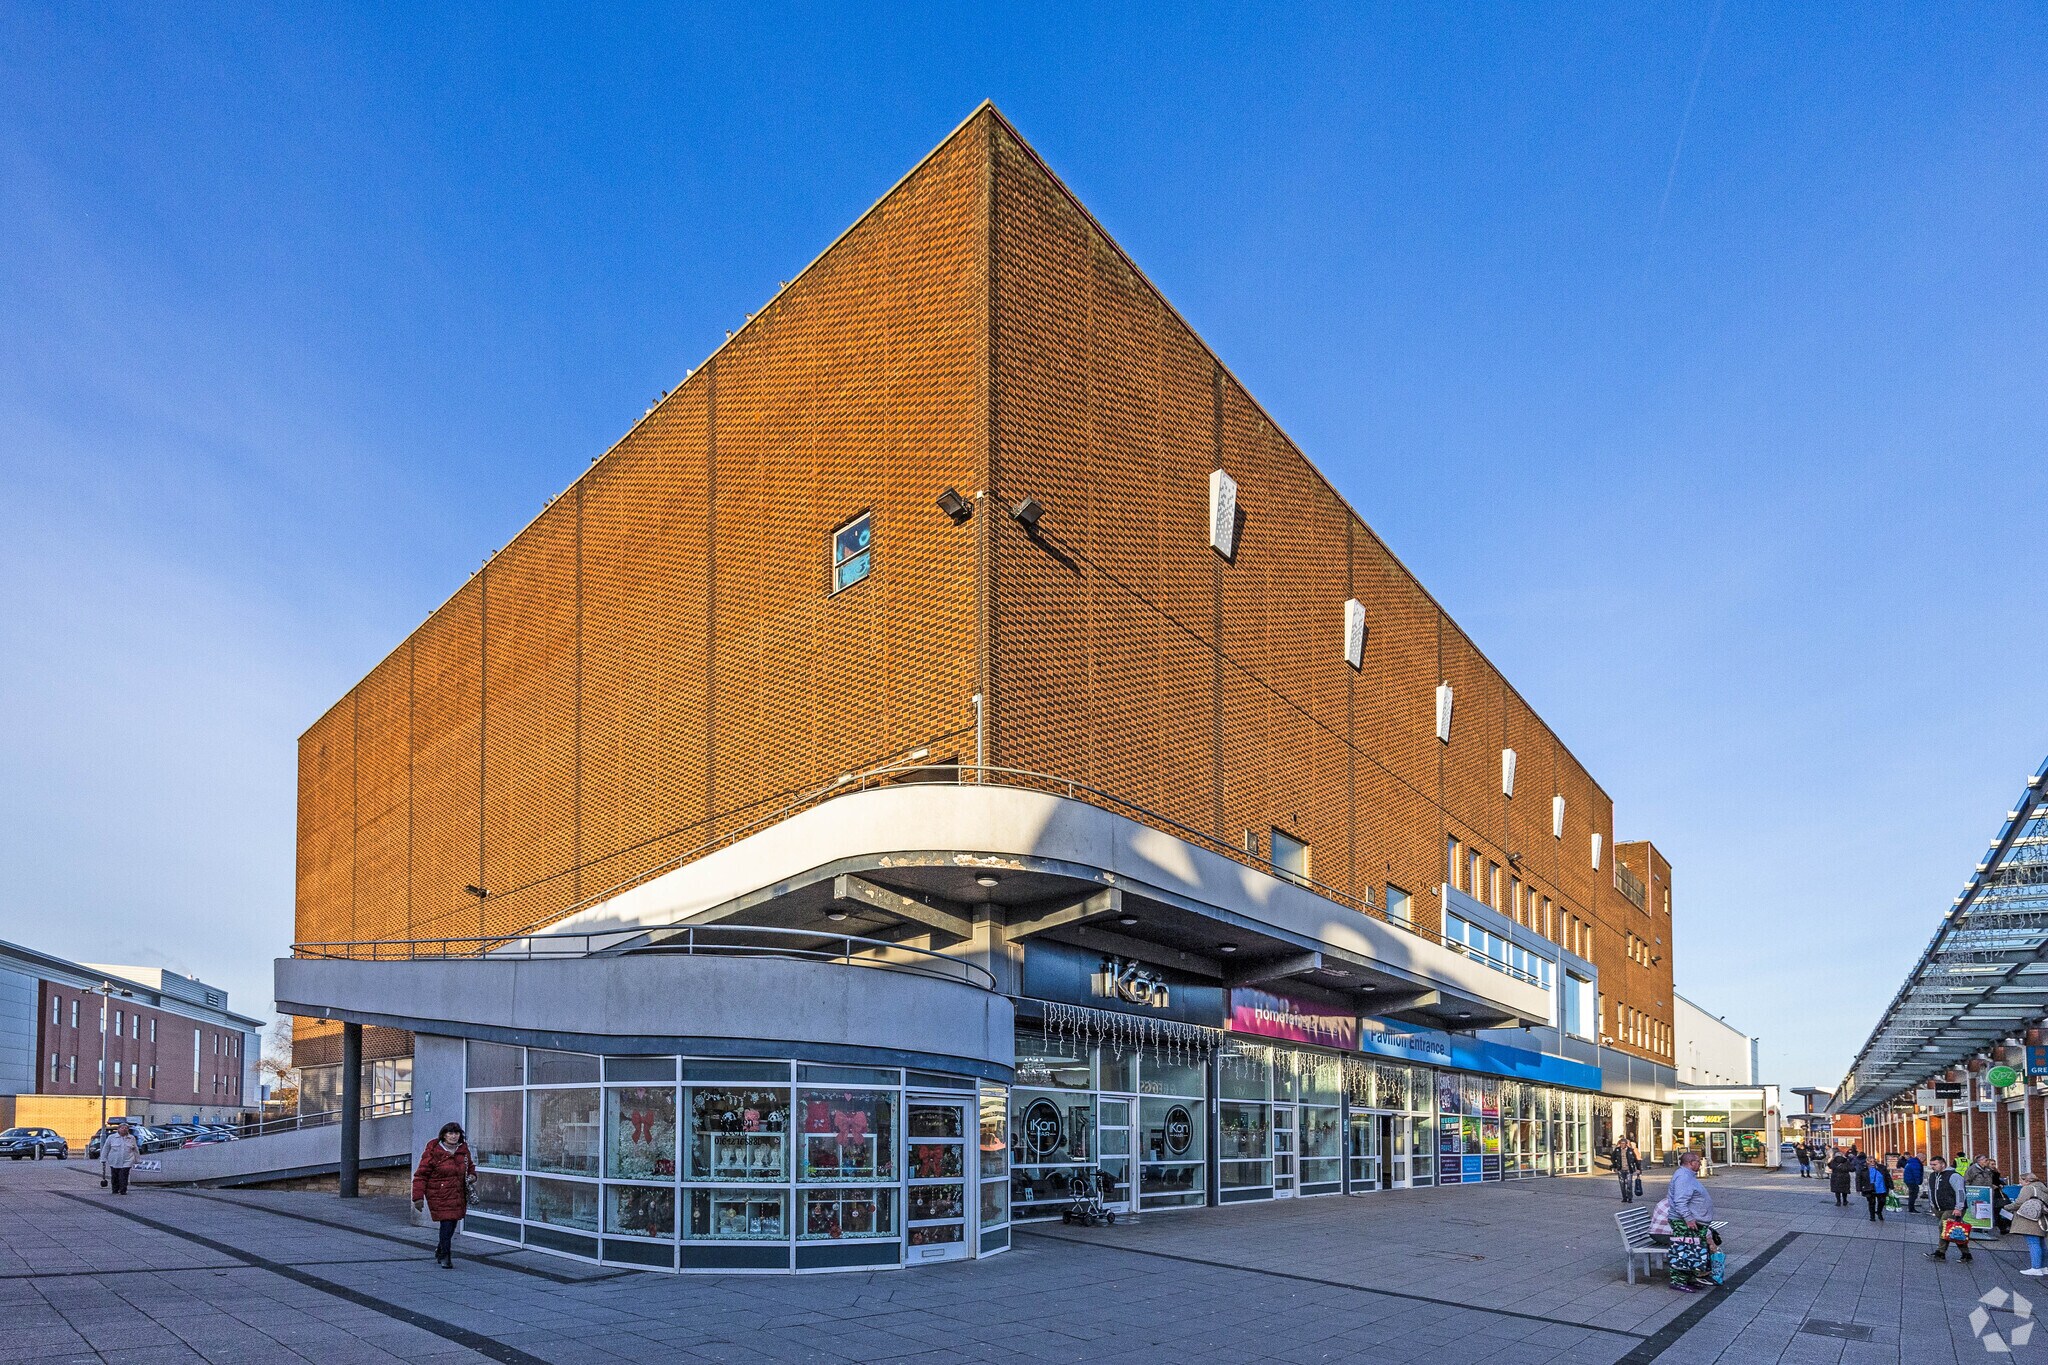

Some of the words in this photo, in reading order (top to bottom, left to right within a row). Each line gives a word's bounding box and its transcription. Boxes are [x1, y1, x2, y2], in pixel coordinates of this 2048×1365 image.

[1370, 1029, 1407, 1048] Pavilion
[1409, 1035, 1445, 1055] Entrance
[1990, 1071, 2012, 1080] VPZ
[1687, 1115, 1726, 1123] SUBWAY
